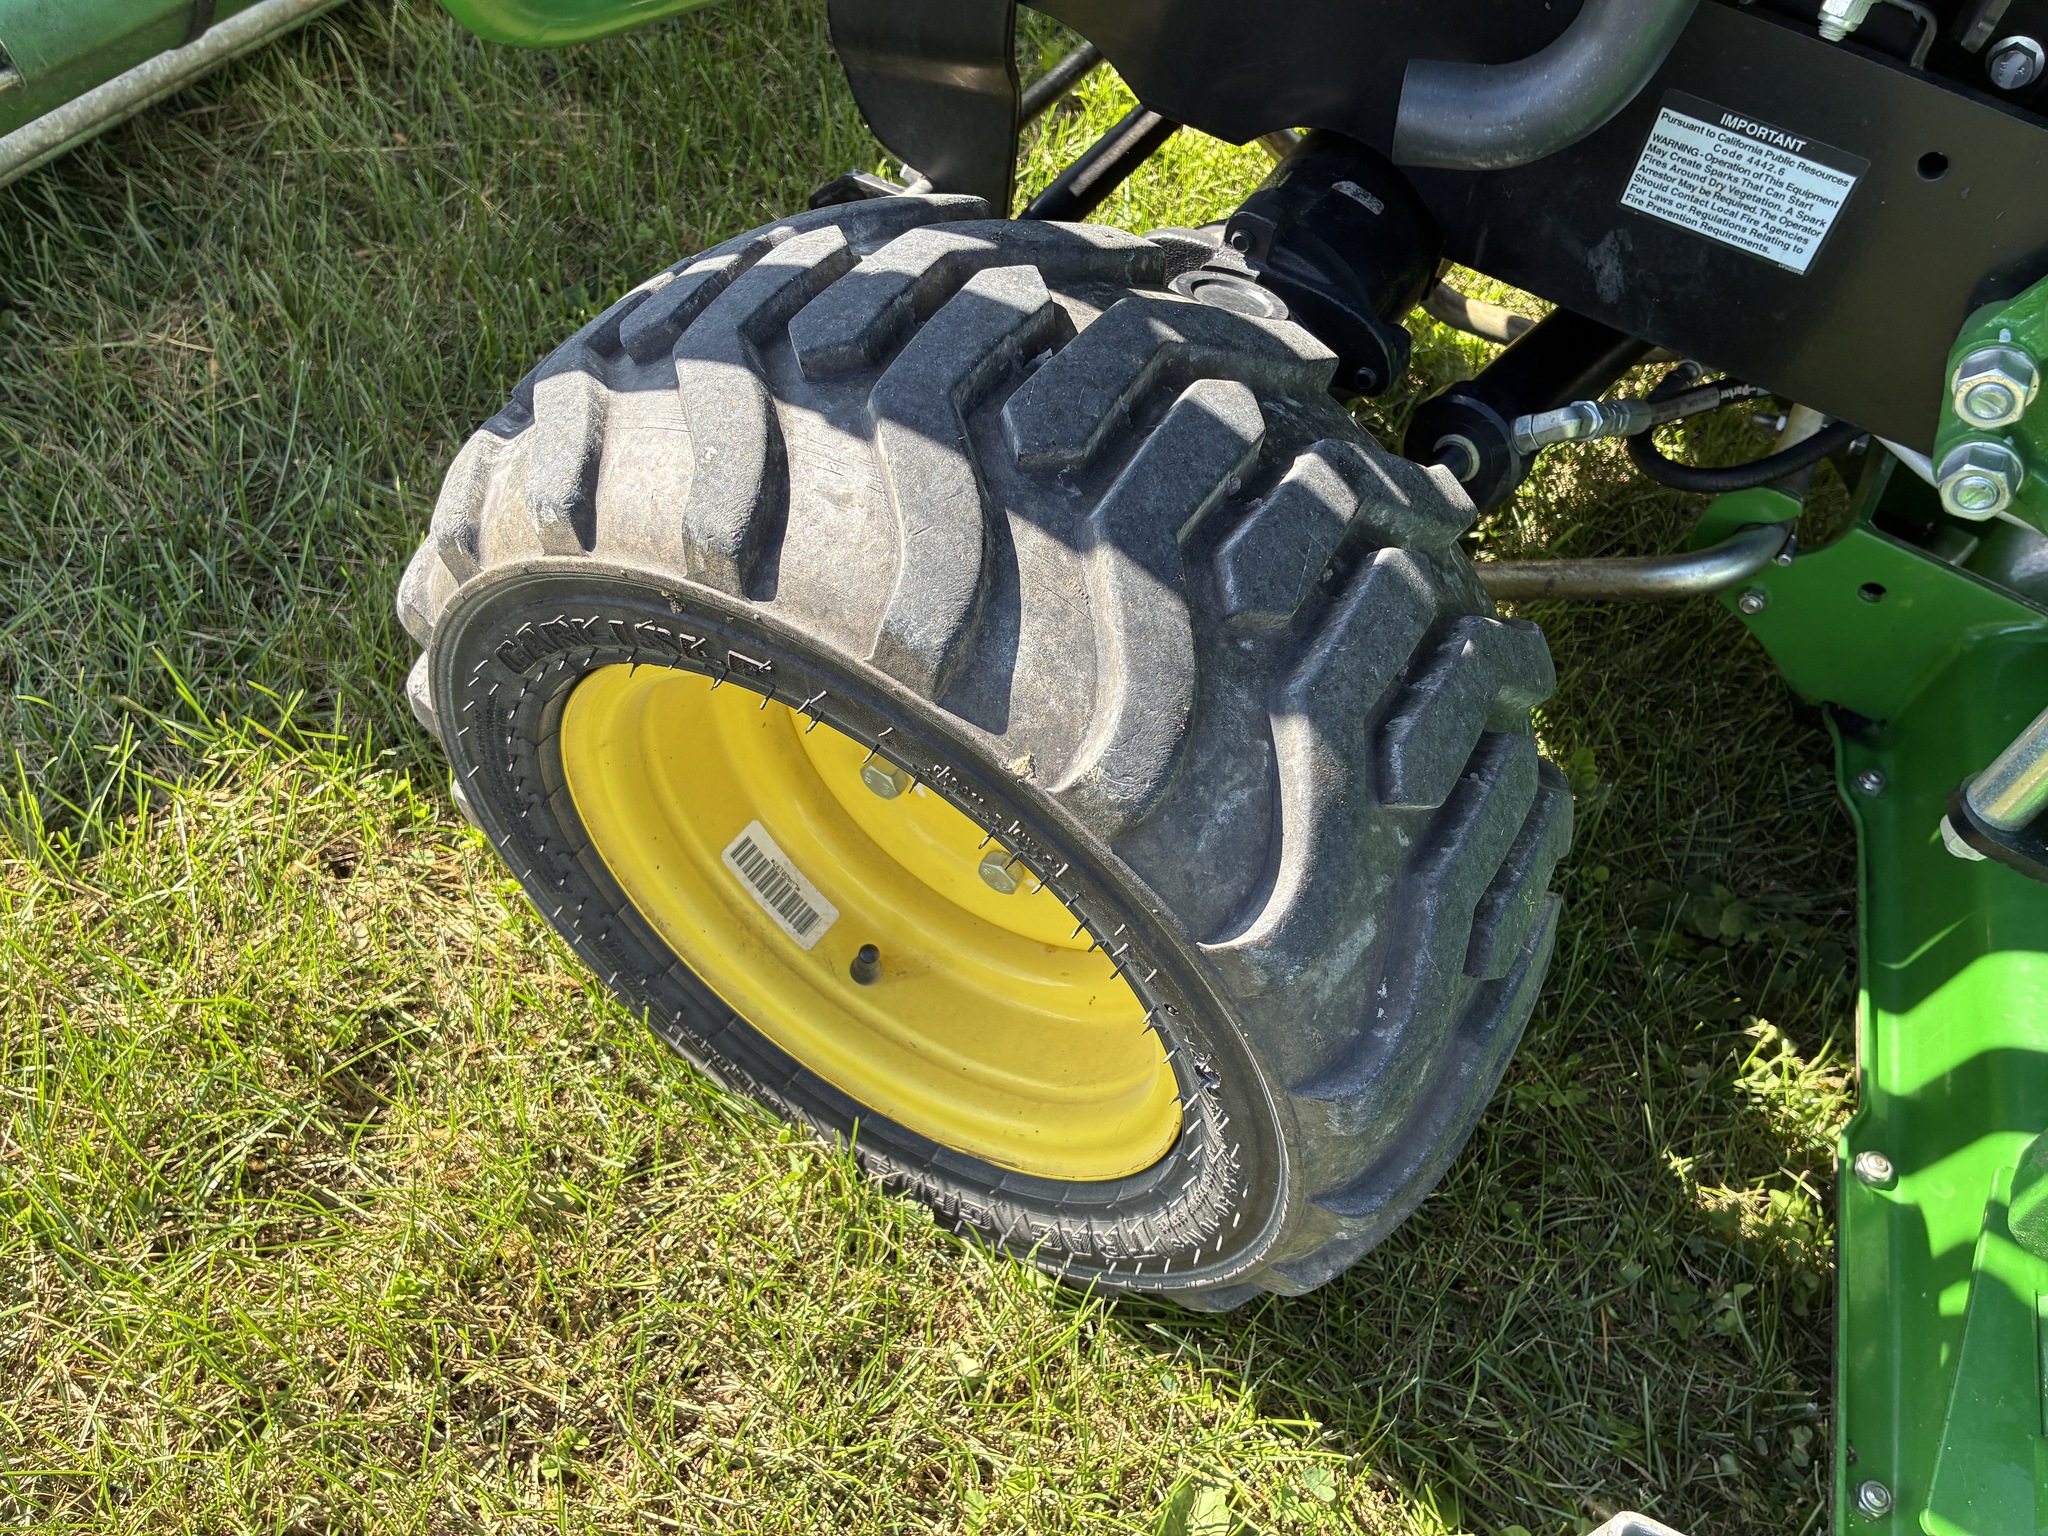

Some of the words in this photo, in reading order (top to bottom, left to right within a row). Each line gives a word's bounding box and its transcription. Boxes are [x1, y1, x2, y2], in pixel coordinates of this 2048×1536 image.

[1660, 111, 1706, 135] Pursuant
[1705, 128, 1716, 139] to
[1717, 132, 1764, 156] California
[1764, 149, 1796, 168] Public
[1796, 161, 1850, 187] Resources
[1712, 143, 1743, 161] Code
[1746, 156, 1786, 177] 4442.6
[1719, 112, 1807, 153] IMPORTANT
[1637, 163, 1678, 184] Arrestor
[1677, 178, 1699, 194] May
[1698, 185, 1712, 198] be
[1712, 190, 1758, 215] Required.
[1759, 207, 1778, 222] The
[1778, 215, 1822, 238] Operator
[1642, 153, 1668, 170] Fires
[1668, 163, 1708, 184] Around
[1707, 177, 1727, 193] Dry
[1728, 184, 1783, 212] Vegetation.
[1784, 206, 1794, 216] A
[1795, 210, 1827, 228] Spark
[1646, 142, 1669, 159] May
[1669, 151, 1703, 171] Create
[1703, 164, 1740, 184] Sparks
[1741, 177, 1764, 193] That
[1765, 187, 1786, 201] Can
[1787, 195, 1814, 211] Start
[1652, 132, 1700, 157] WARNING
[1704, 152, 1752, 177] Operation
[1752, 171, 1765, 181] of
[1764, 173, 1785, 189] This
[1785, 182, 1840, 209] Equipment
[1624, 192, 1645, 207] Fire
[1645, 200, 1698, 227] Prevention
[1699, 221, 1770, 254] Requirements.
[1629, 182, 1647, 196] For
[1647, 189, 1674, 206] Laws
[1675, 202, 1688, 211] or
[1688, 205, 1748, 234] Regulations
[1748, 227, 1792, 252] Relating
[1792, 244, 1804, 255] to
[1633, 173, 1670, 193] Should
[1670, 187, 1710, 208] Contact
[1710, 201, 1740, 219] Local
[1739, 213, 1760, 227] Fire
[1761, 221, 1809, 245] Agencies
